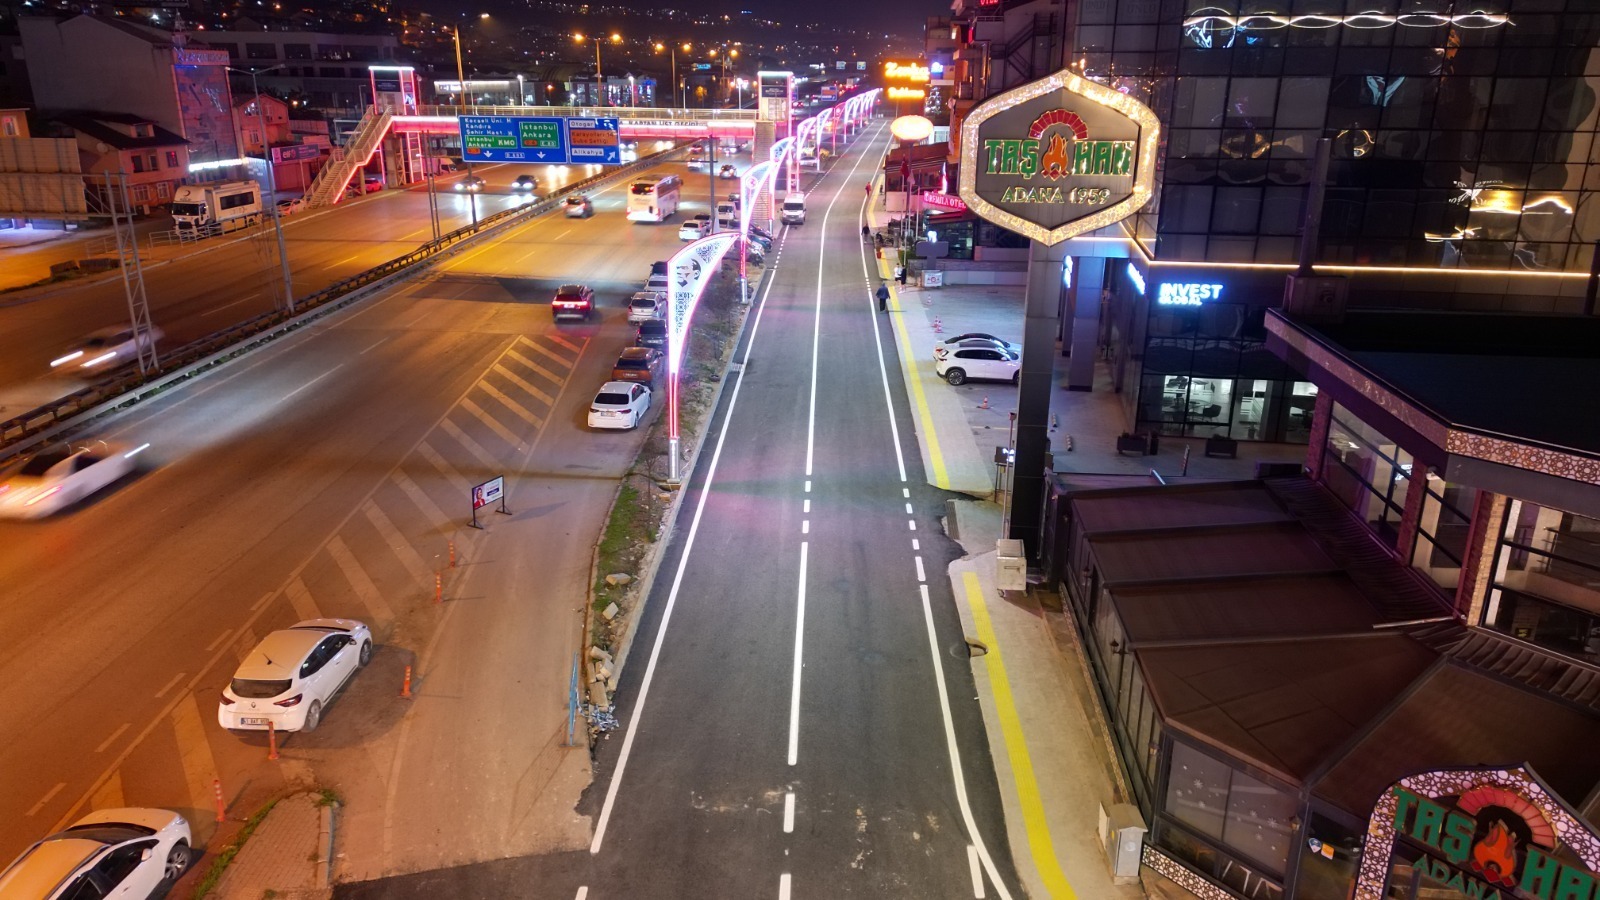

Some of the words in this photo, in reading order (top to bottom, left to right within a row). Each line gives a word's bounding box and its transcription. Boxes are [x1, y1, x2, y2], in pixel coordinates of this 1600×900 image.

[985, 139, 1040, 180] TAŞ
[1071, 140, 1136, 177] HAN
[1001, 186, 1065, 204] ADANA
[1070, 187, 1111, 205] 1959
[1160, 283, 1224, 299] INVEST
[1520, 843, 1600, 900] HA
